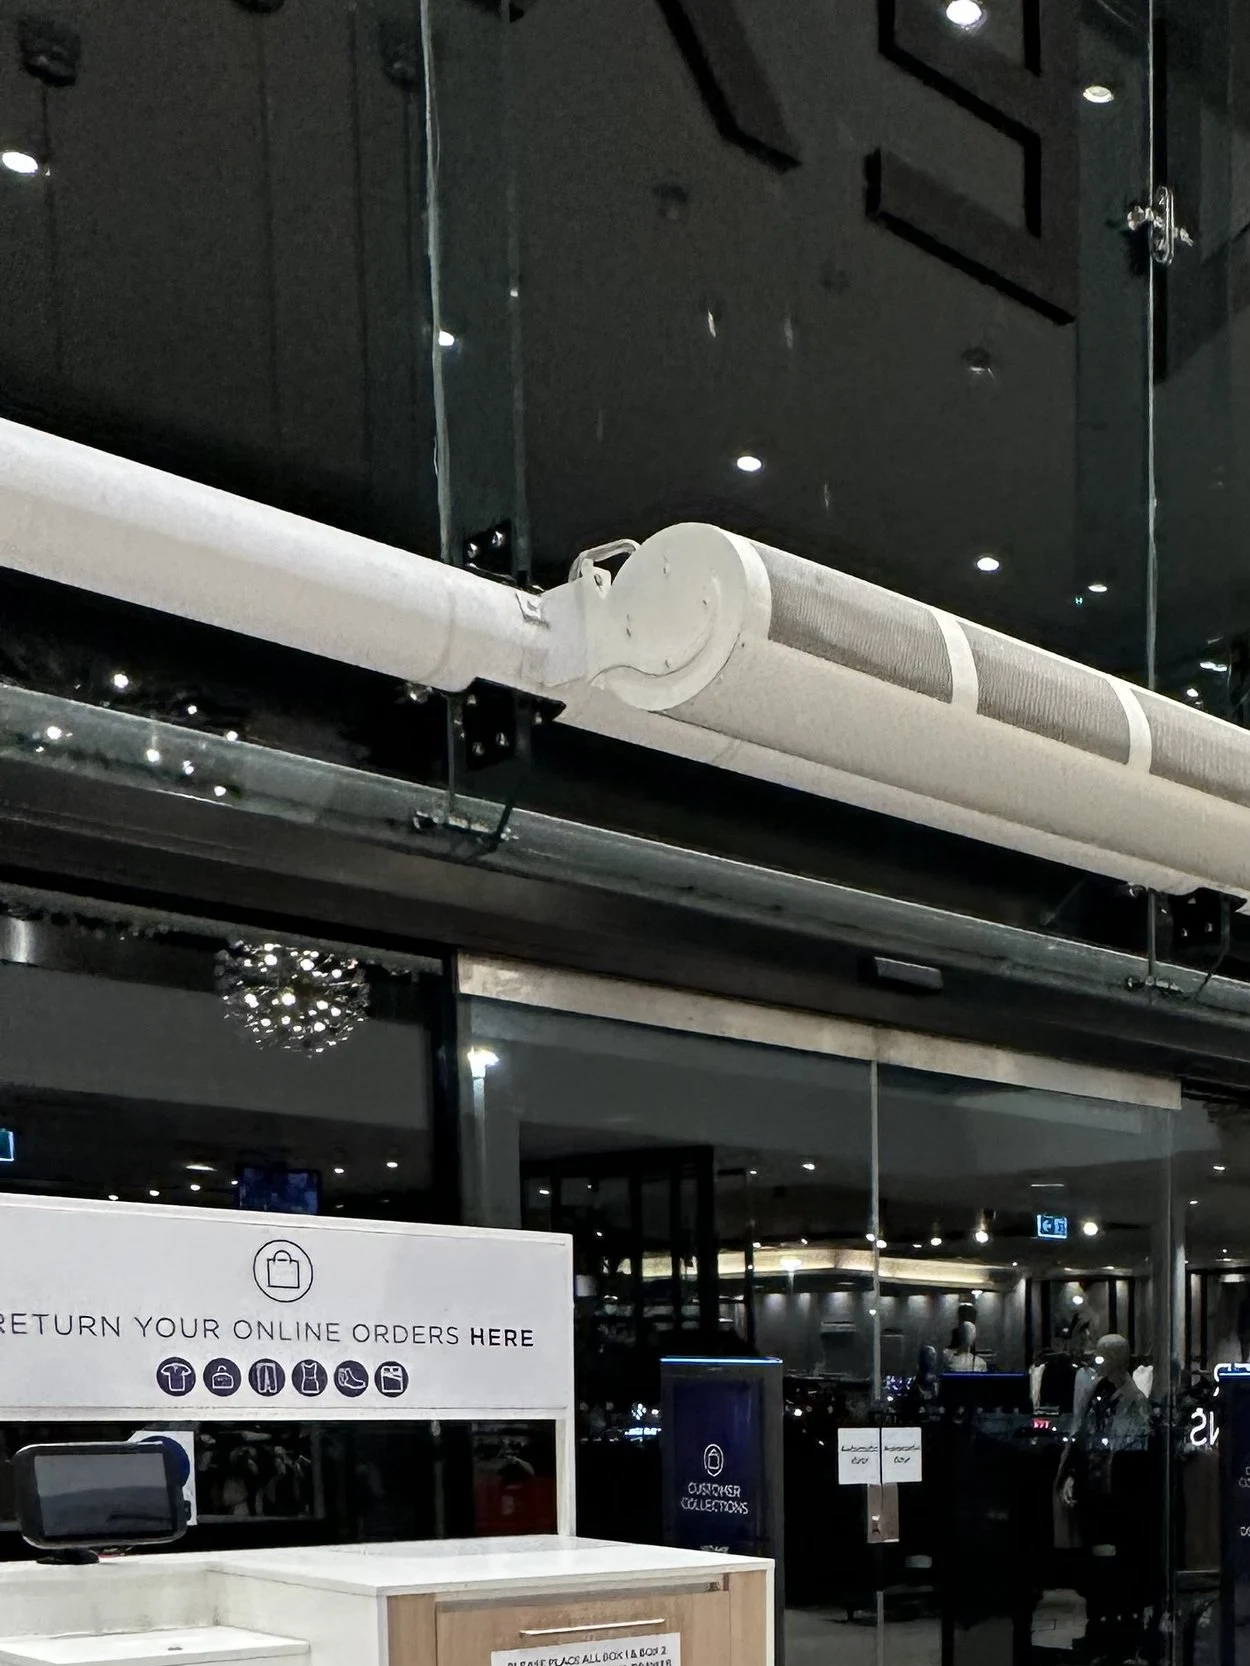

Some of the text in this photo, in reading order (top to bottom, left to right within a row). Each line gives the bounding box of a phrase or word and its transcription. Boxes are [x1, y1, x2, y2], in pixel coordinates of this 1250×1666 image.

[134, 1316, 219, 1340] YOUR
[233, 1319, 341, 1342] ONLINE
[352, 1323, 459, 1345] ORDERS
[470, 1327, 534, 1347] HERE
[688, 1482, 741, 1498] CUSTOMER
[680, 1496, 749, 1515] COLLECTIONS
[582, 1653, 601, 1664] ALL
[602, 1651, 624, 1662] BOX
[639, 1647, 659, 1658] BOX
[660, 1645, 668, 1656] 2
